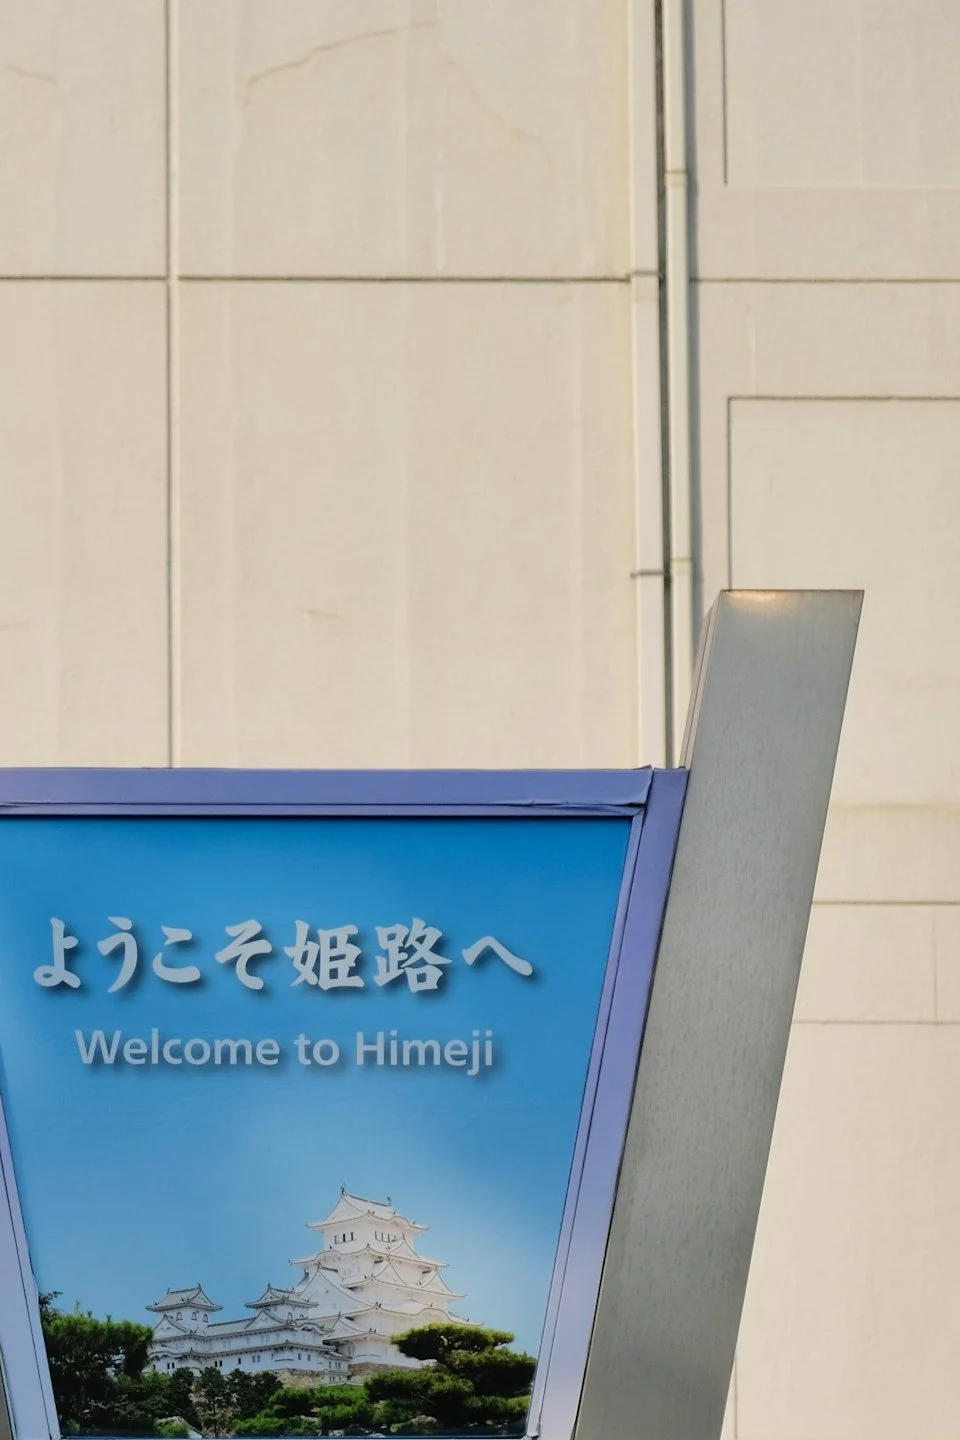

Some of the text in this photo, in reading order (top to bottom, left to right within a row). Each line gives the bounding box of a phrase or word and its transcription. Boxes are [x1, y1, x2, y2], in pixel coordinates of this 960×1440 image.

[33, 916, 534, 994] ようこそ姫路へ
[75, 1028, 495, 1076] Welcome to Himeji
